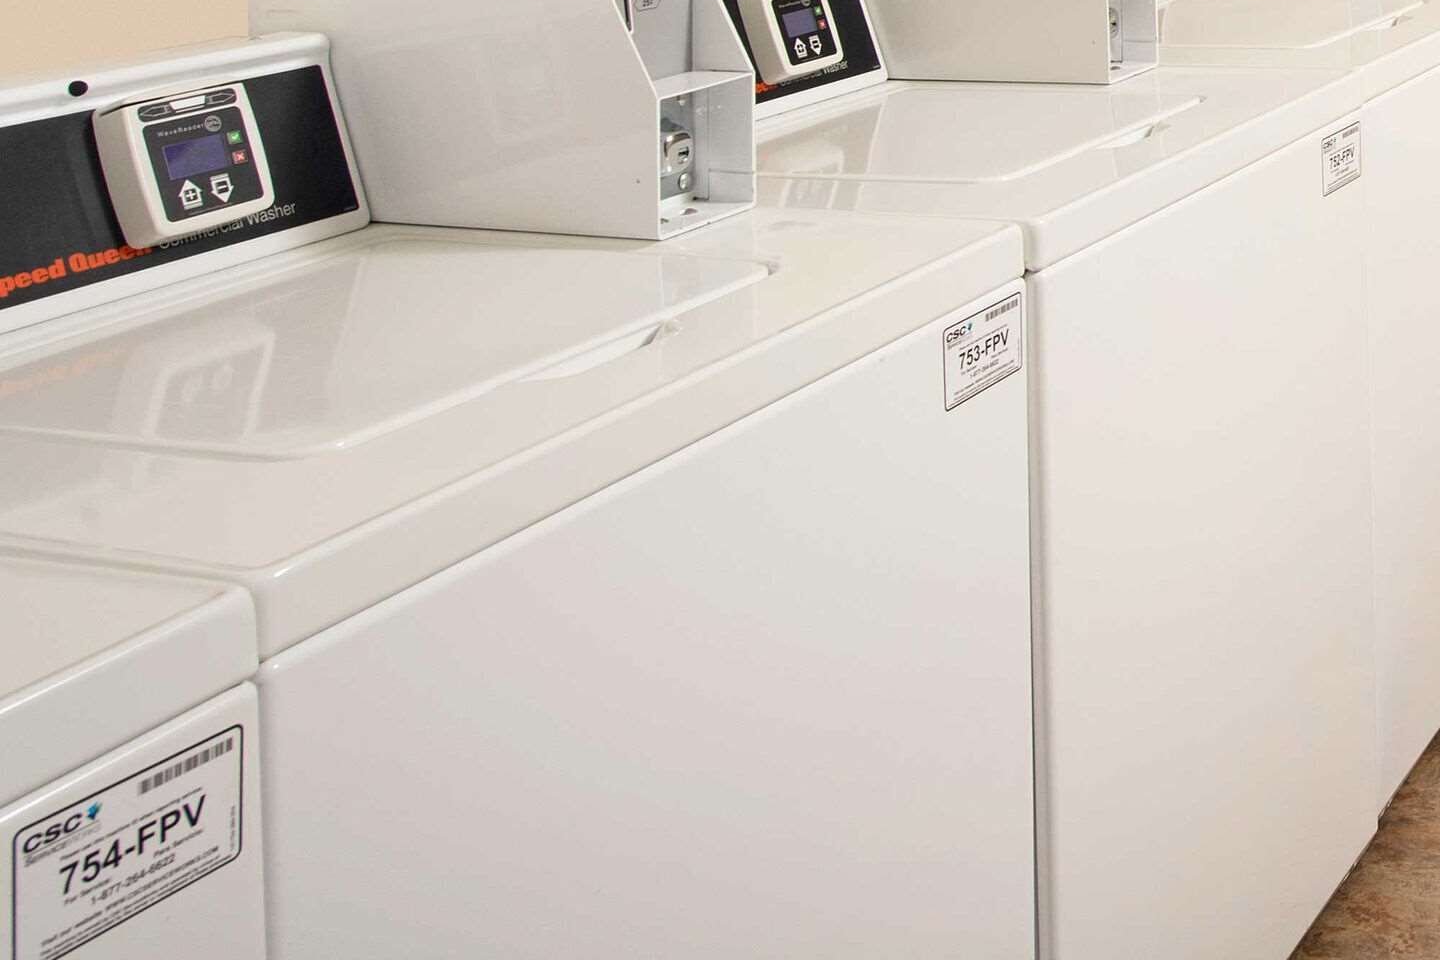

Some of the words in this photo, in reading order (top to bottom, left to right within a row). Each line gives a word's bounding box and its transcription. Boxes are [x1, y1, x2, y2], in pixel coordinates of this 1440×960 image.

[247, 203, 296, 226] Washer
[946, 326, 966, 343] CSC
[959, 328, 1009, 370] 753-FPV
[23, 813, 82, 853] CSC
[58, 795, 206, 895] 754-FPV
